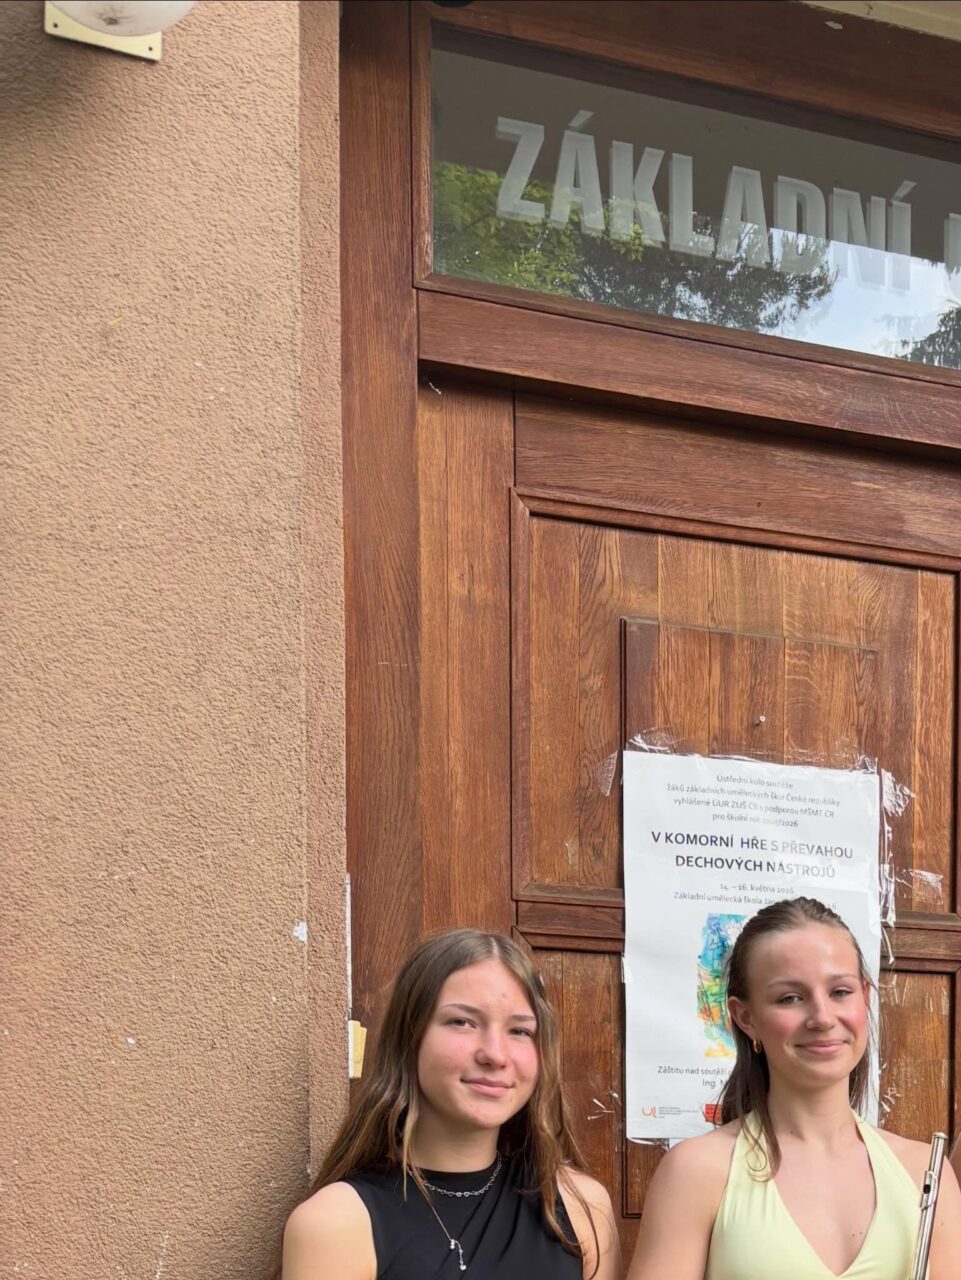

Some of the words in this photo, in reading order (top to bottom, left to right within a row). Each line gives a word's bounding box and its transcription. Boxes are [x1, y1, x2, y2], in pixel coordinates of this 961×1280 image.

[496, 110, 917, 291] ZÁKLADNÍ
[716, 775, 749, 785] Ústřední
[686, 785, 726, 796] základních
[727, 788, 770, 800] uměleckých
[771, 792, 784, 801] škol
[786, 793, 807, 803] České
[808, 797, 840, 807] republiky
[673, 797, 711, 806] vyhlášené
[731, 800, 747, 809] ZUŠ
[764, 805, 799, 815] podporou
[800, 807, 823, 817] MŠMT
[712, 813, 726, 821] pro
[726, 812, 748, 823] školní
[749, 815, 760, 823] rok
[651, 831, 661, 843] V
[665, 832, 734, 848] KOMORNÍ
[740, 836, 768, 850] HŘE
[770, 840, 779, 851] S
[781, 840, 853, 859] PŘEVAHOU
[675, 855, 763, 872] DECHOVÝCH
[766, 860, 835, 878] NÁSTROJŮ
[750, 884, 775, 893] května
[673, 892, 706, 900] Základní
[707, 895, 742, 904] umělecká
[743, 896, 762, 905] škola
[657, 1066, 684, 1074] Záštitu
[685, 1067, 699, 1075] nad
